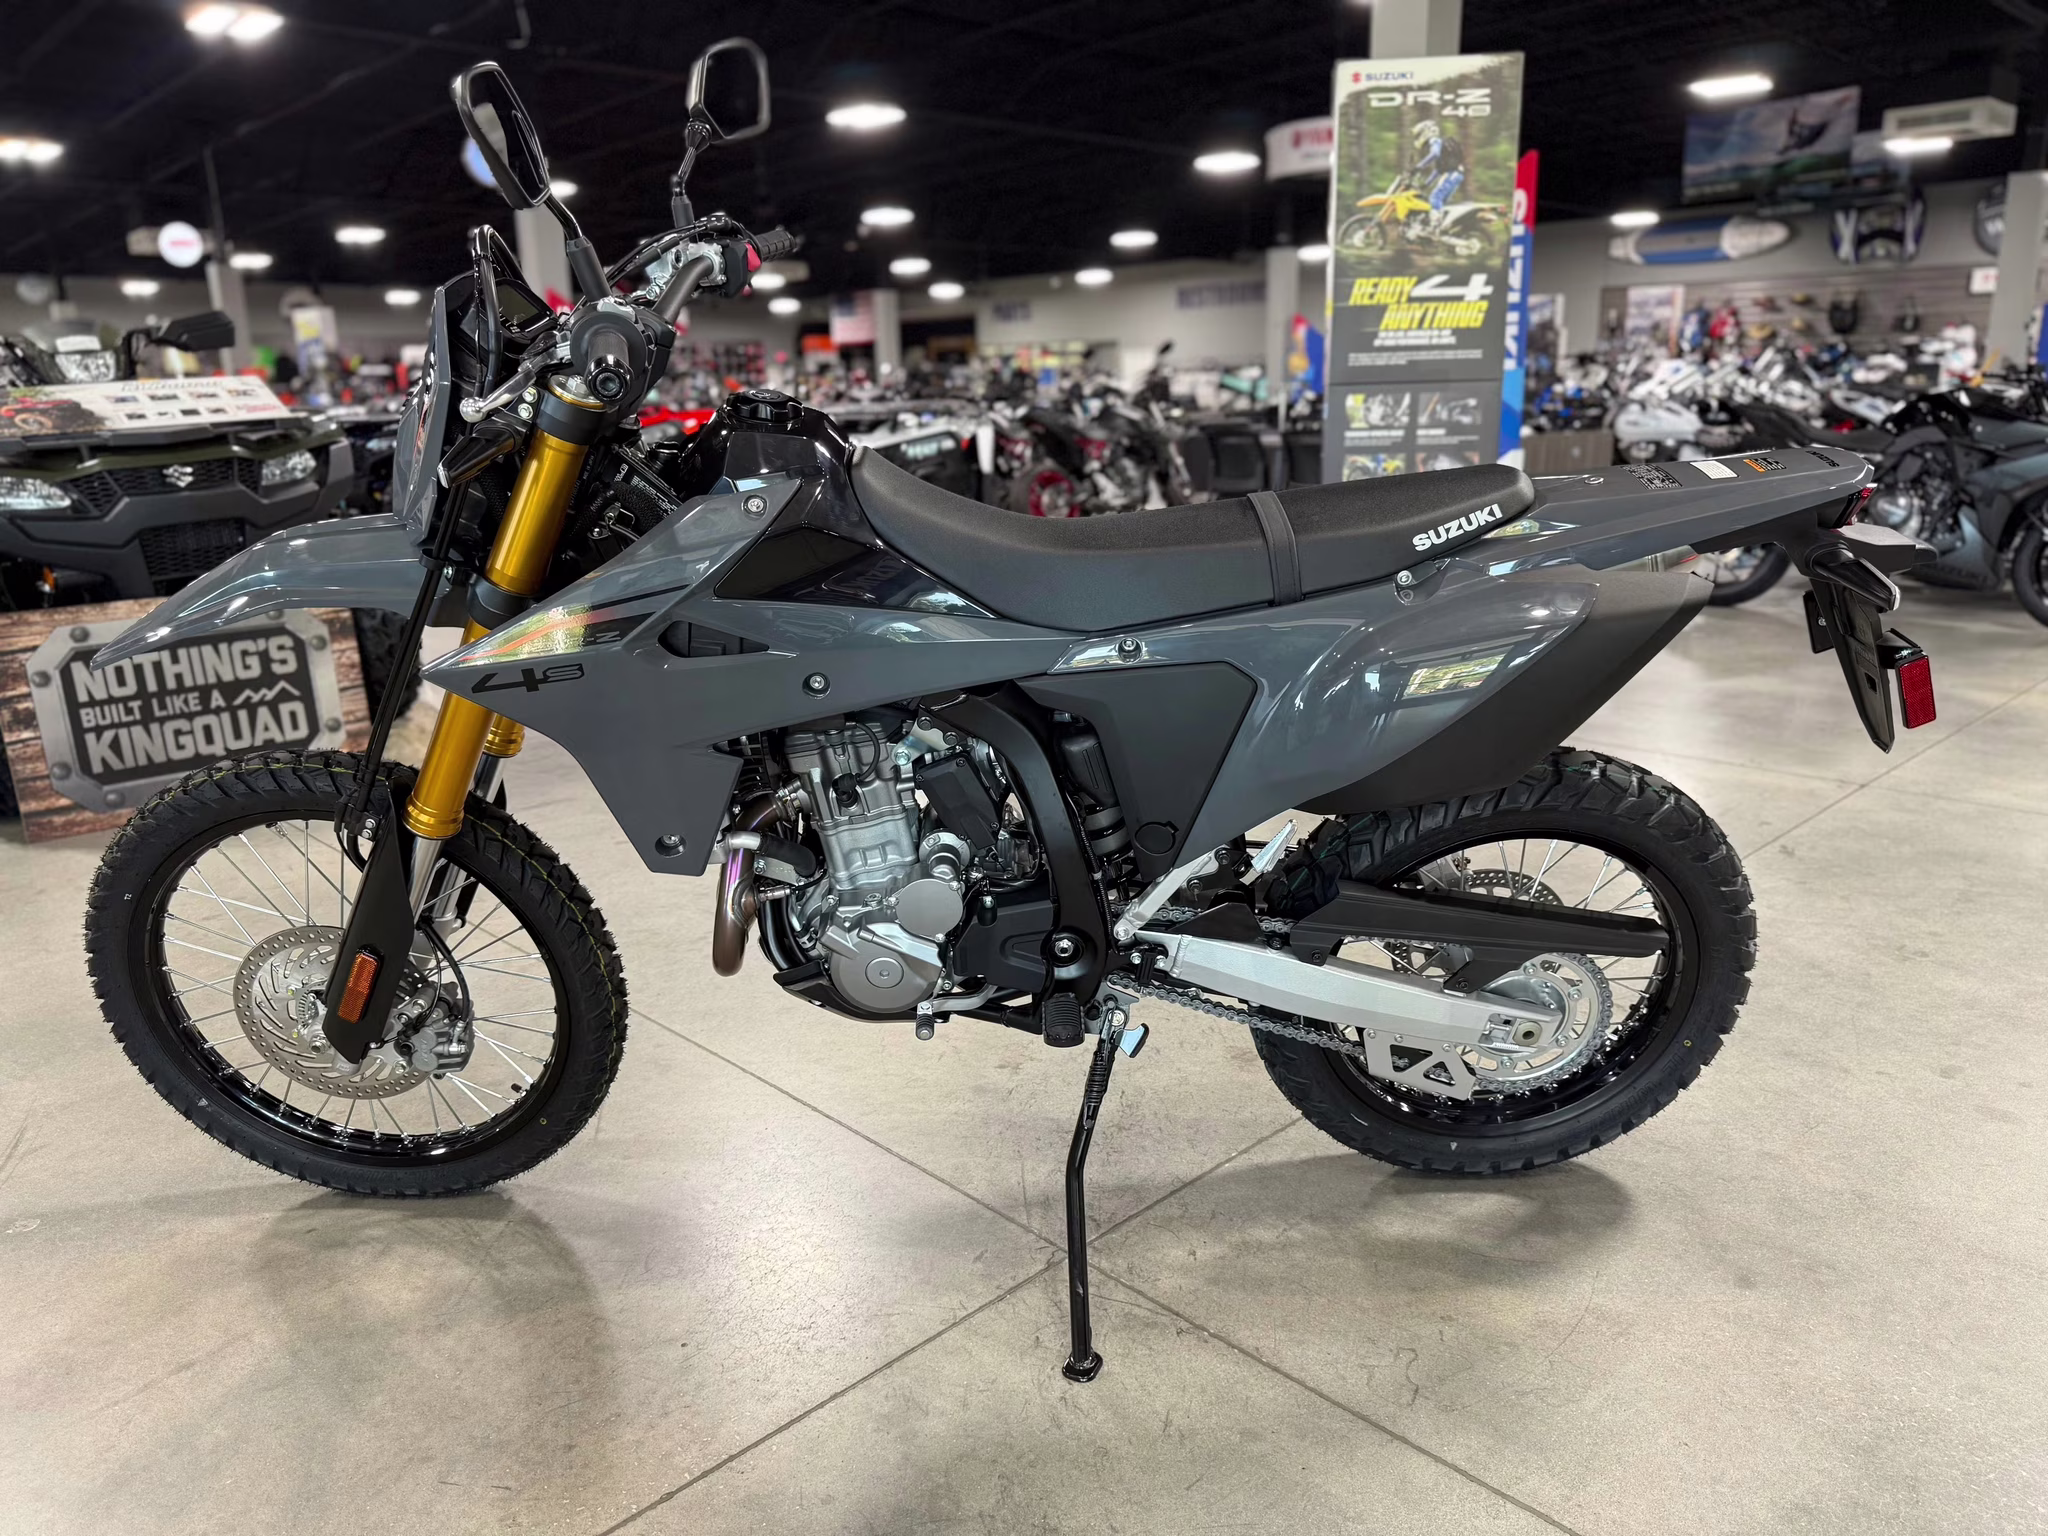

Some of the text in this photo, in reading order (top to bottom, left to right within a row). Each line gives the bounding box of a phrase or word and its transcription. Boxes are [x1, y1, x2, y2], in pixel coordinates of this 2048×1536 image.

[1365, 72, 1414, 81] SUZUKI
[1368, 88, 1491, 107] DR-Z
[1348, 273, 1494, 305] READY 4
[1379, 299, 1489, 330] ANYTHING
[1412, 503, 1503, 551] SUZUKI
[70, 634, 298, 702] NOTHING'S
[79, 689, 226, 728] BUILT LIKE A
[84, 701, 310, 774] KINGQUAD
